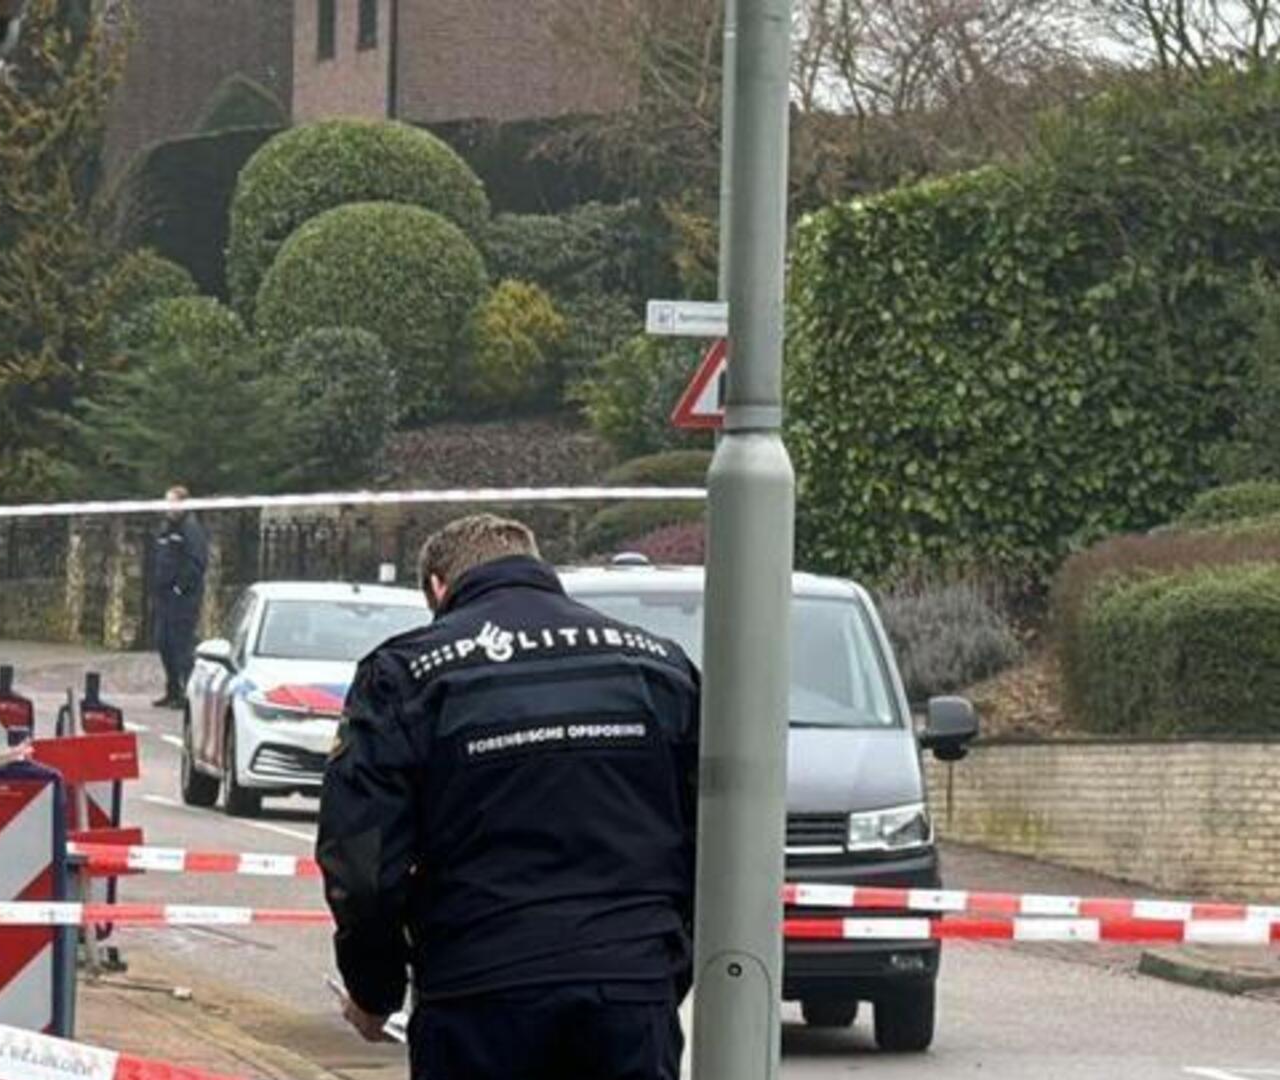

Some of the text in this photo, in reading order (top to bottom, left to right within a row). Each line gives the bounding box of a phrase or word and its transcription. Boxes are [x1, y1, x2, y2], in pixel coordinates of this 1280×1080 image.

[456, 620, 624, 664] POLITIE
[467, 723, 646, 755] FORENSISCHE OPSPORING
